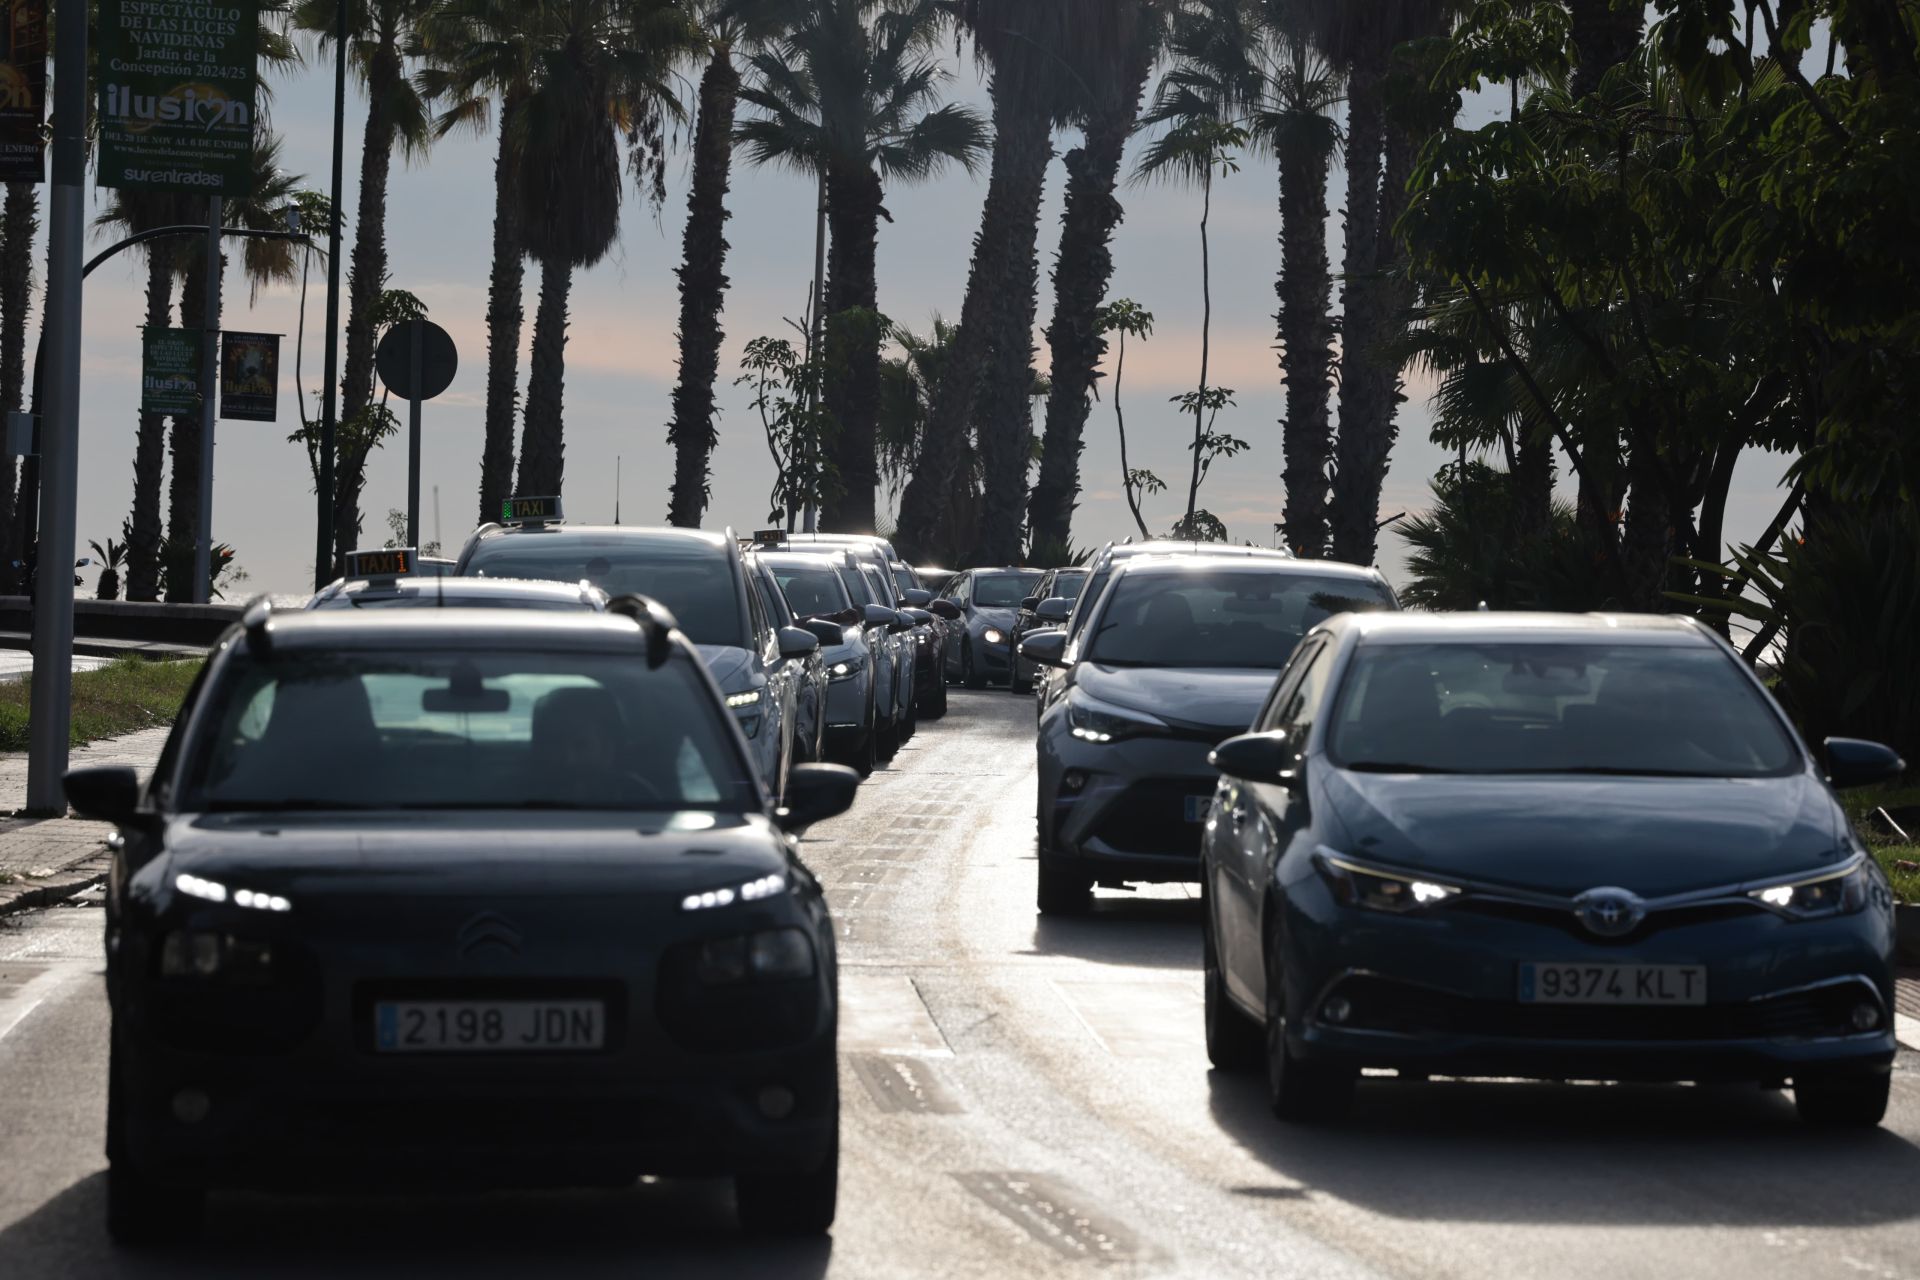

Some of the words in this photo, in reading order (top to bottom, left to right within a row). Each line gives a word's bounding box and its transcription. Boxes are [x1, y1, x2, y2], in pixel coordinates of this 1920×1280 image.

[120, 16, 143, 29] DE
[147, 18, 177, 31] LAS
[182, 19, 237, 35] LUCES
[136, 45, 180, 61] Jardín
[184, 49, 201, 62] de
[204, 50, 216, 63] la
[110, 58, 192, 76] Concepción
[196, 64, 247, 80] 2024/25
[152, 135, 172, 145] NOV
[213, 139, 249, 150] ENERO
[514, 500, 544, 517] TAXI
[358, 554, 395, 575] TAXI
[1542, 968, 1624, 999] 9374
[1635, 968, 1698, 1000] KLT
[404, 1008, 505, 1044] 2198
[521, 1007, 594, 1044] JDN
